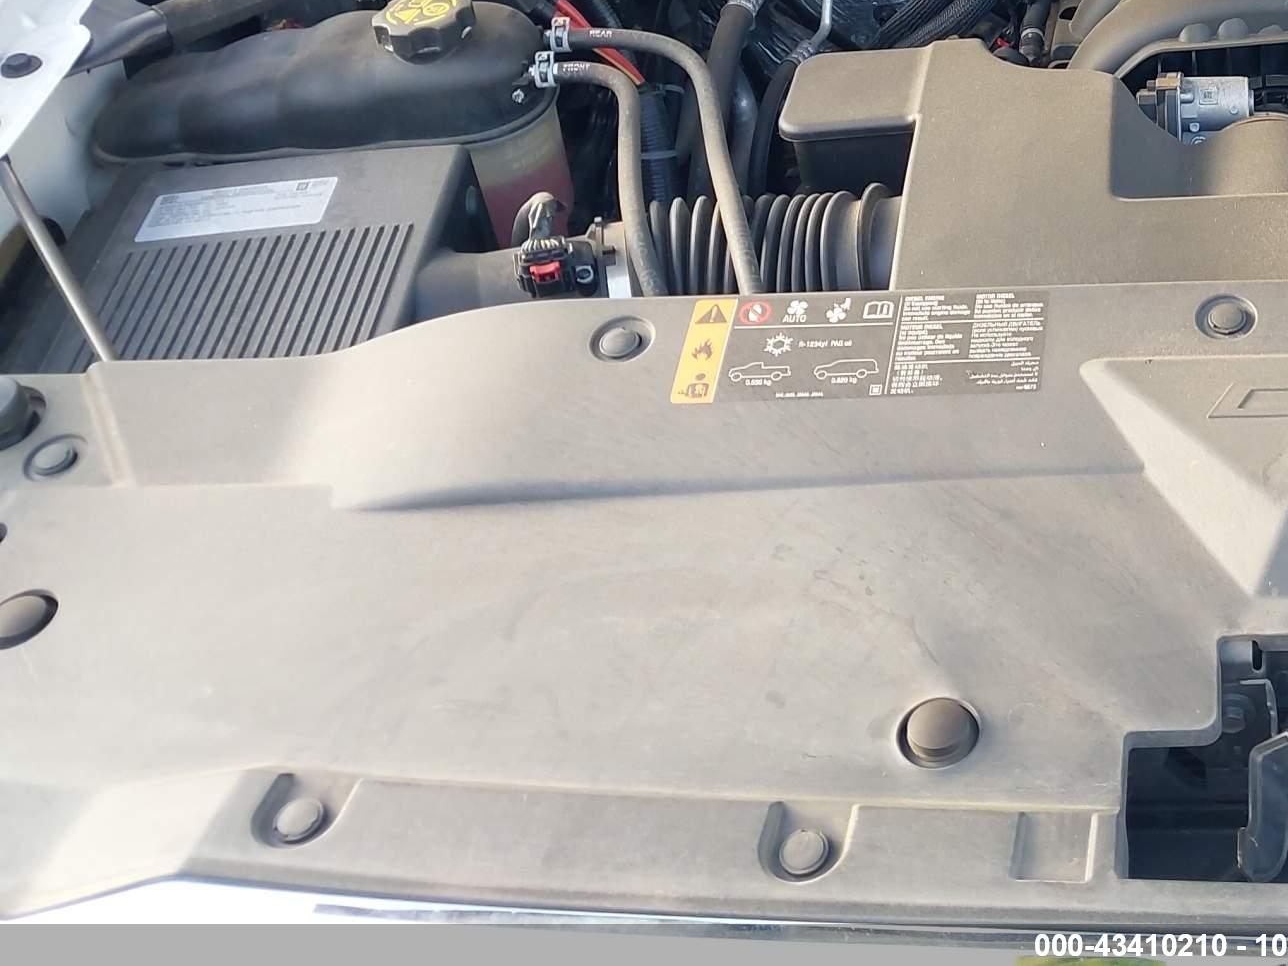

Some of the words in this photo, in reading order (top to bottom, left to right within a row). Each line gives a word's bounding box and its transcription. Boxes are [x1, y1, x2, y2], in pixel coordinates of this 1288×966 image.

[589, 29, 613, 38] REAR
[562, 63, 590, 72] FRONT
[782, 314, 807, 323] AUTO
